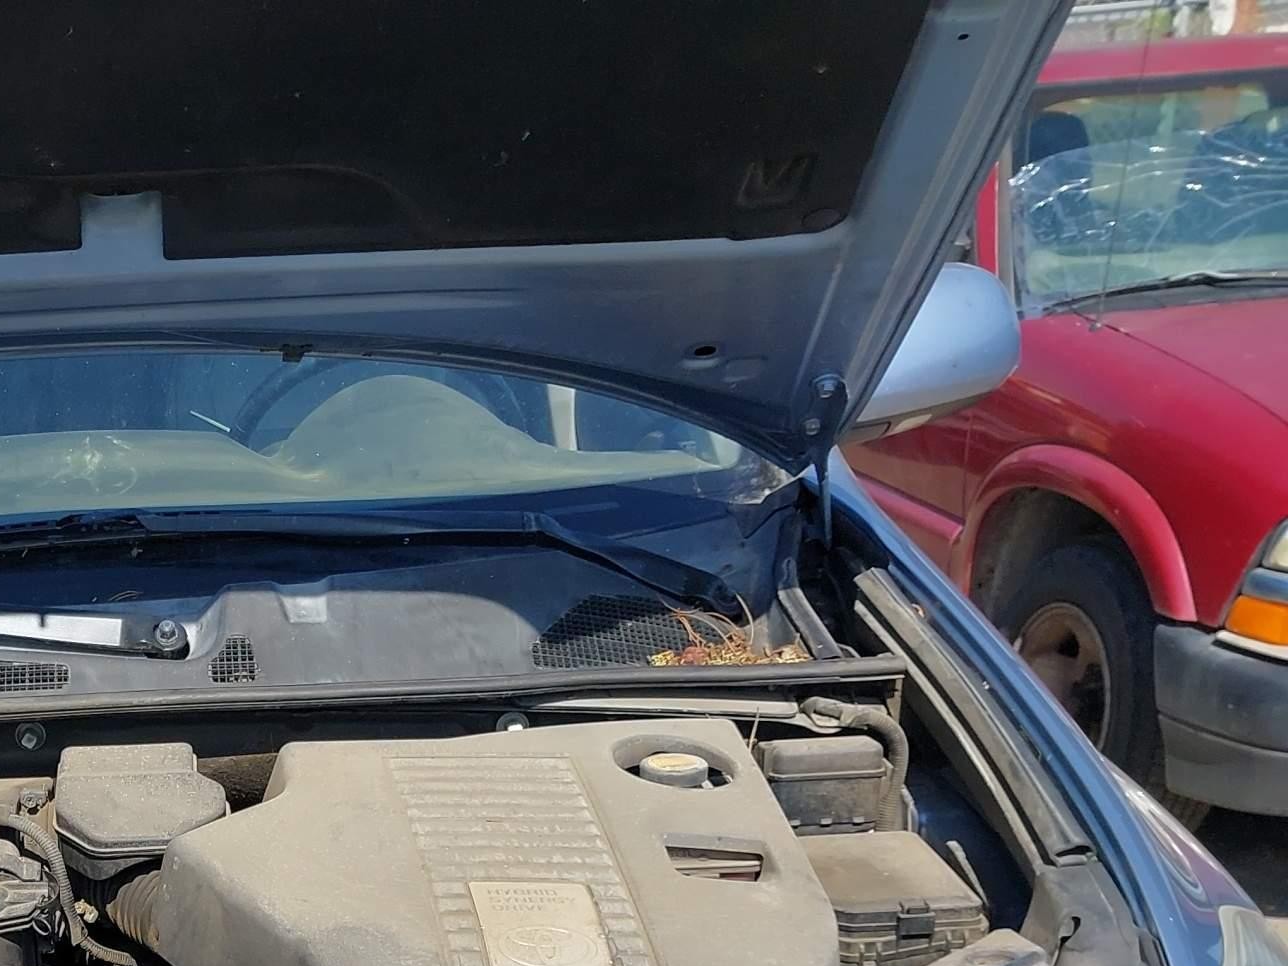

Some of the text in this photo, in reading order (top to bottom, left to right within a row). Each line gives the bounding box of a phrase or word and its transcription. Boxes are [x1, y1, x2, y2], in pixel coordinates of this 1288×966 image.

[488, 888, 558, 896] HYBRID
[488, 896, 576, 904] SYNERGY
[490, 904, 547, 912] DRIVE
